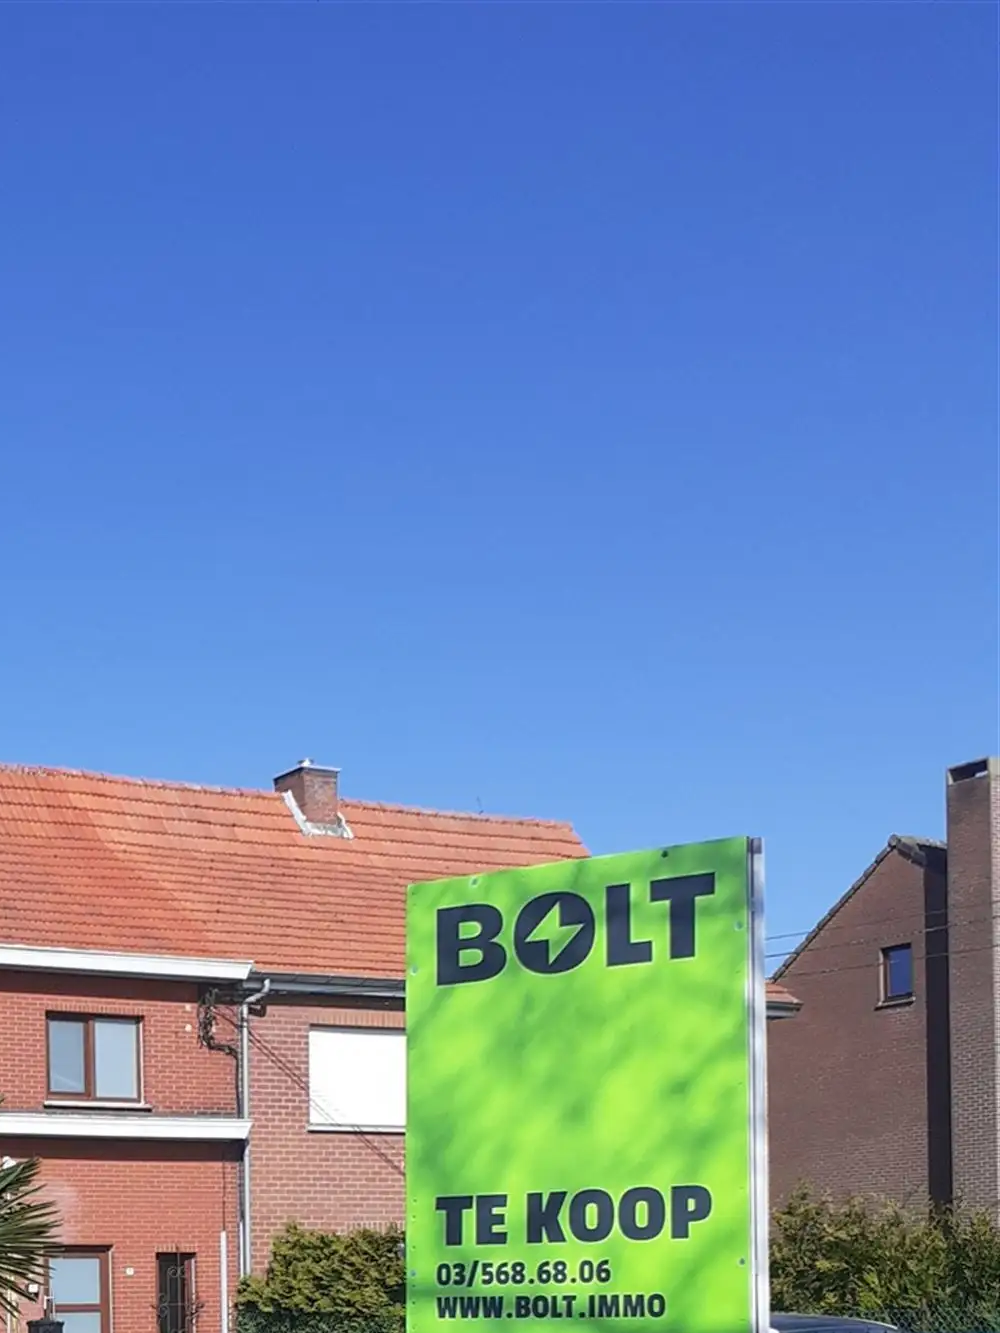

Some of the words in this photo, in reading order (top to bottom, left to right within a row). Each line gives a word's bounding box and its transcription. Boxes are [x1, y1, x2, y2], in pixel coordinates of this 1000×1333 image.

[436, 872, 716, 986] BOLT
[435, 1194, 508, 1246] TE
[526, 1184, 713, 1244] KOOP
[436, 1260, 612, 1287] 03/568.68.06
[436, 1293, 666, 1319] WWW.BOLT.IMMO
